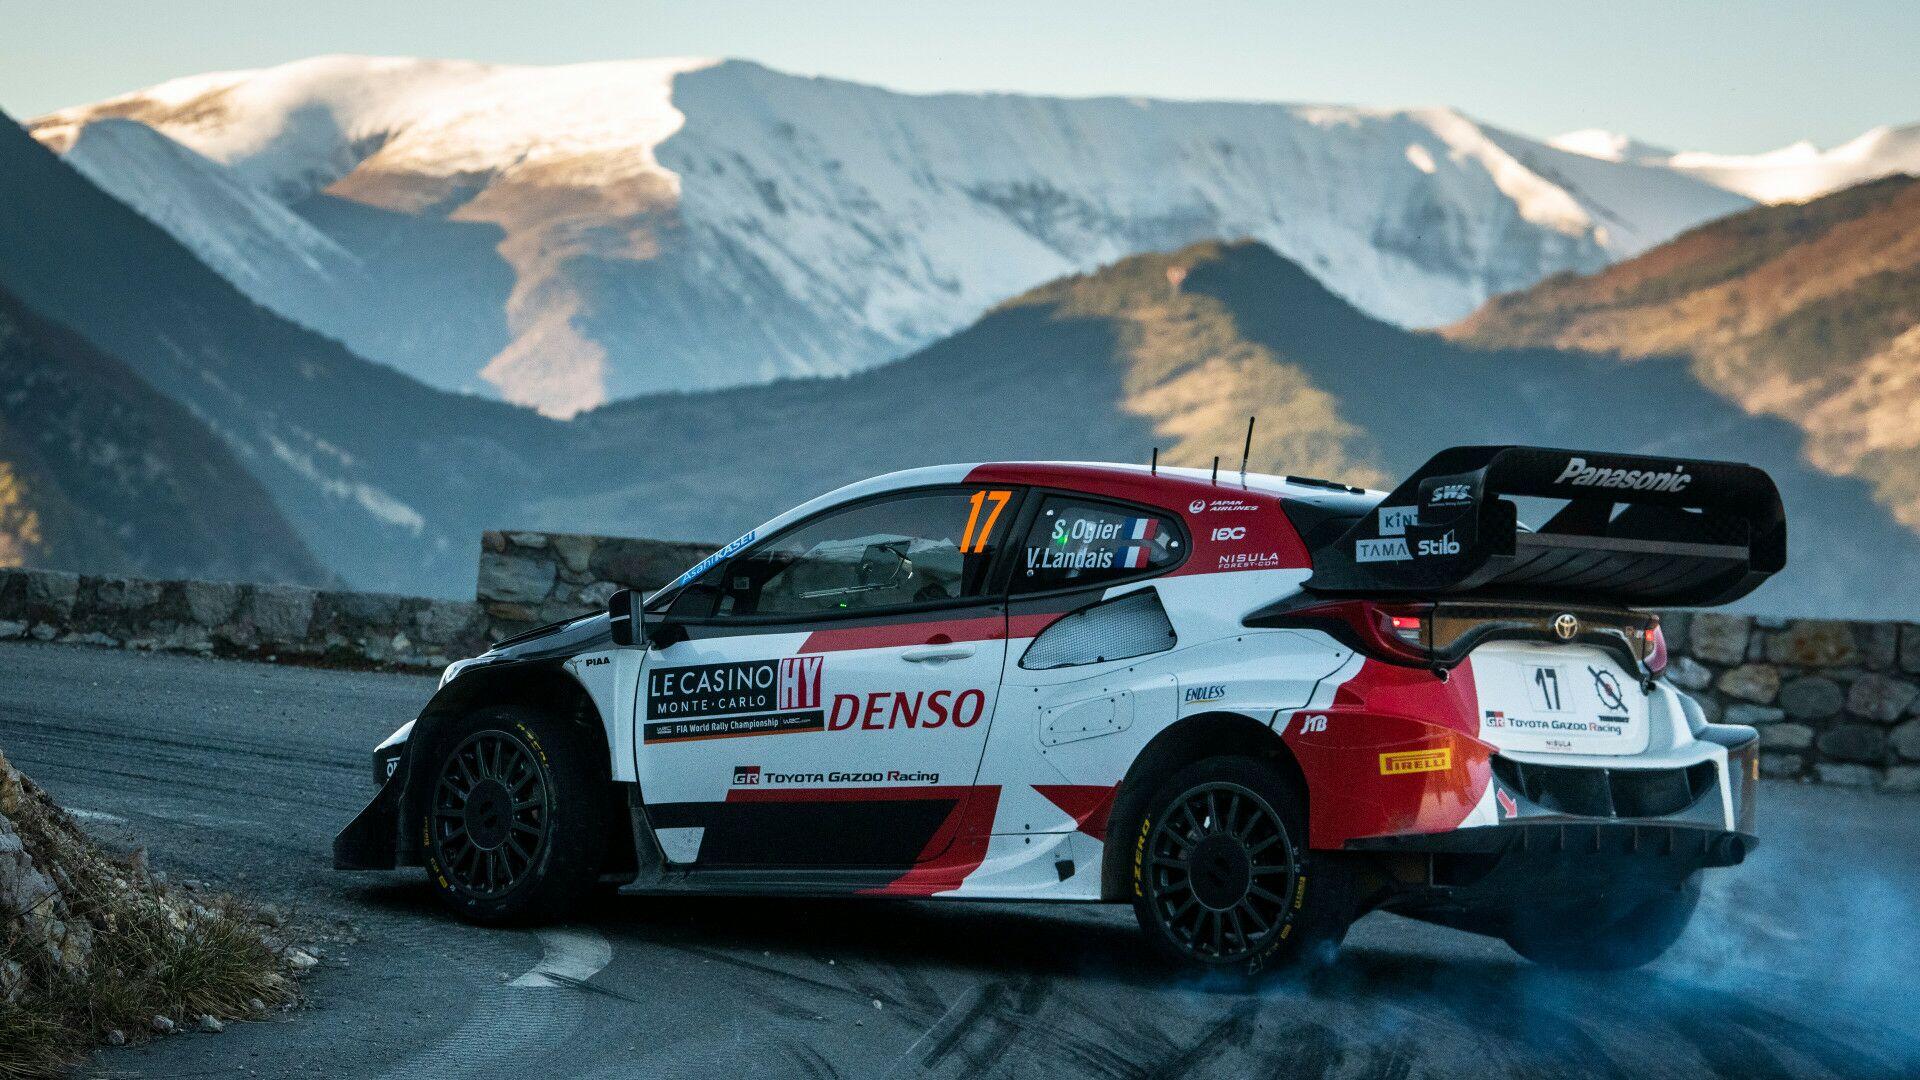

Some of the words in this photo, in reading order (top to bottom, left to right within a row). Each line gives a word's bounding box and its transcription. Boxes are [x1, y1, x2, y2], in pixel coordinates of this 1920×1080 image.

[1554, 457, 1692, 492] Panasonic
[1431, 484, 1472, 502] SWS
[959, 490, 1012, 553] 17
[1418, 528, 1460, 556] Stilo
[1219, 552, 1279, 564] NISULA
[586, 656, 610, 667] PIAA
[651, 673, 675, 697] LE
[680, 665, 774, 695] CASINO
[780, 656, 824, 710] HY
[1535, 667, 1561, 711] 17
[1185, 685, 1226, 701] ENDLESS
[828, 688, 985, 731] DENSO
[676, 725, 688, 734] FIA
[689, 723, 710, 733] World
[711, 721, 729, 732] Rally
[730, 718, 779, 730] Championship
[1300, 714, 1328, 735] JTB
[1508, 717, 1550, 729] TOYOTA
[1551, 720, 1587, 731] GAZOO
[1589, 722, 1622, 736] Racing
[1385, 752, 1446, 771] PIRELLI
[734, 771, 760, 784] GR
[765, 773, 824, 783] TOYOTA
[828, 772, 883, 782] GAZOO
[887, 770, 940, 784] Racing
